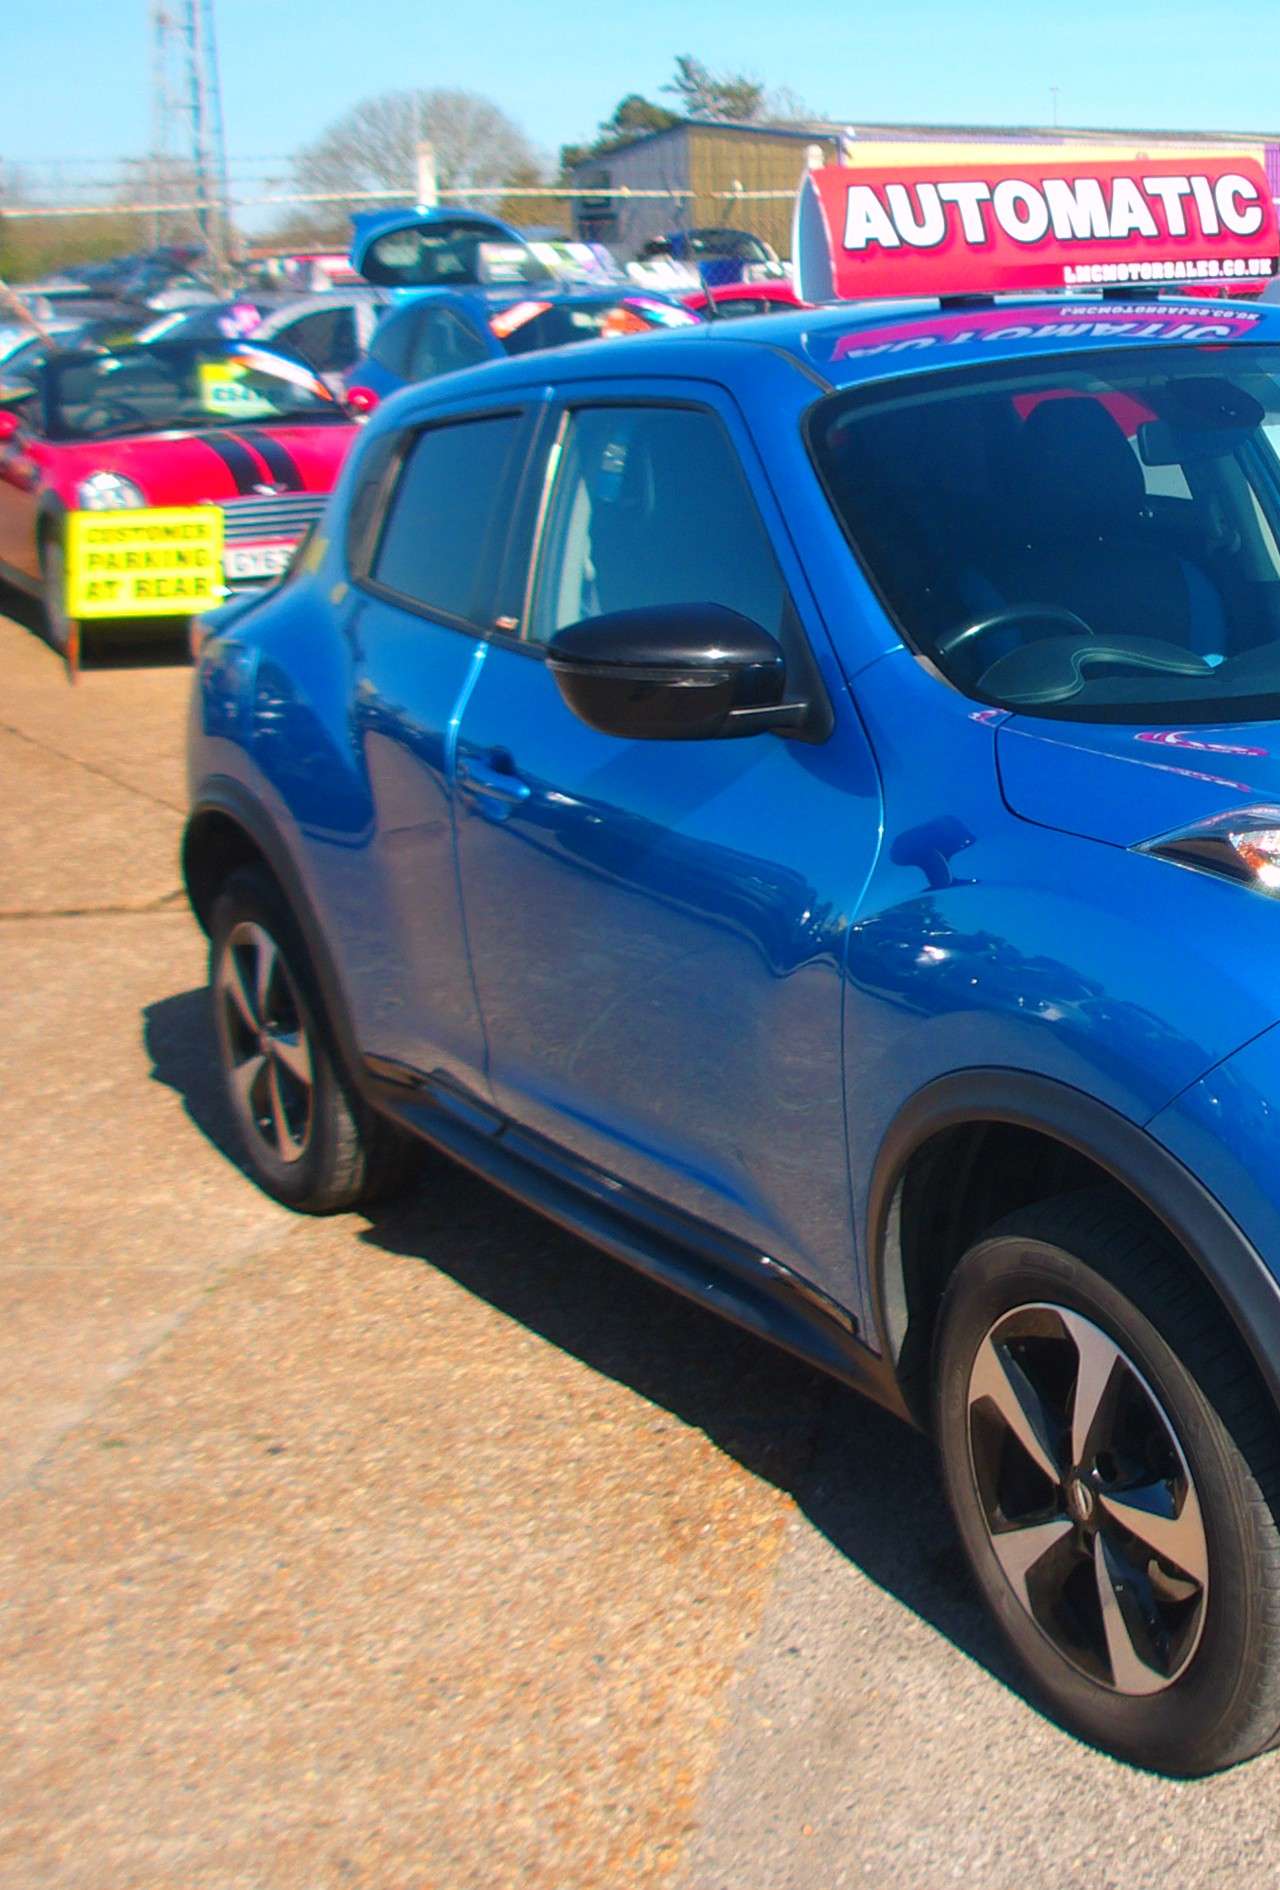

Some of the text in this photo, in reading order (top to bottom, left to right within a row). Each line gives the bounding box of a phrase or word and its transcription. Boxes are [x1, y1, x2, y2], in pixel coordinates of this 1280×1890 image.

[842, 174, 1264, 250] AUTOMATIC
[87, 524, 208, 544] CUSTOMER
[87, 550, 208, 570] PARKING
[86, 577, 208, 600] AT REAR
